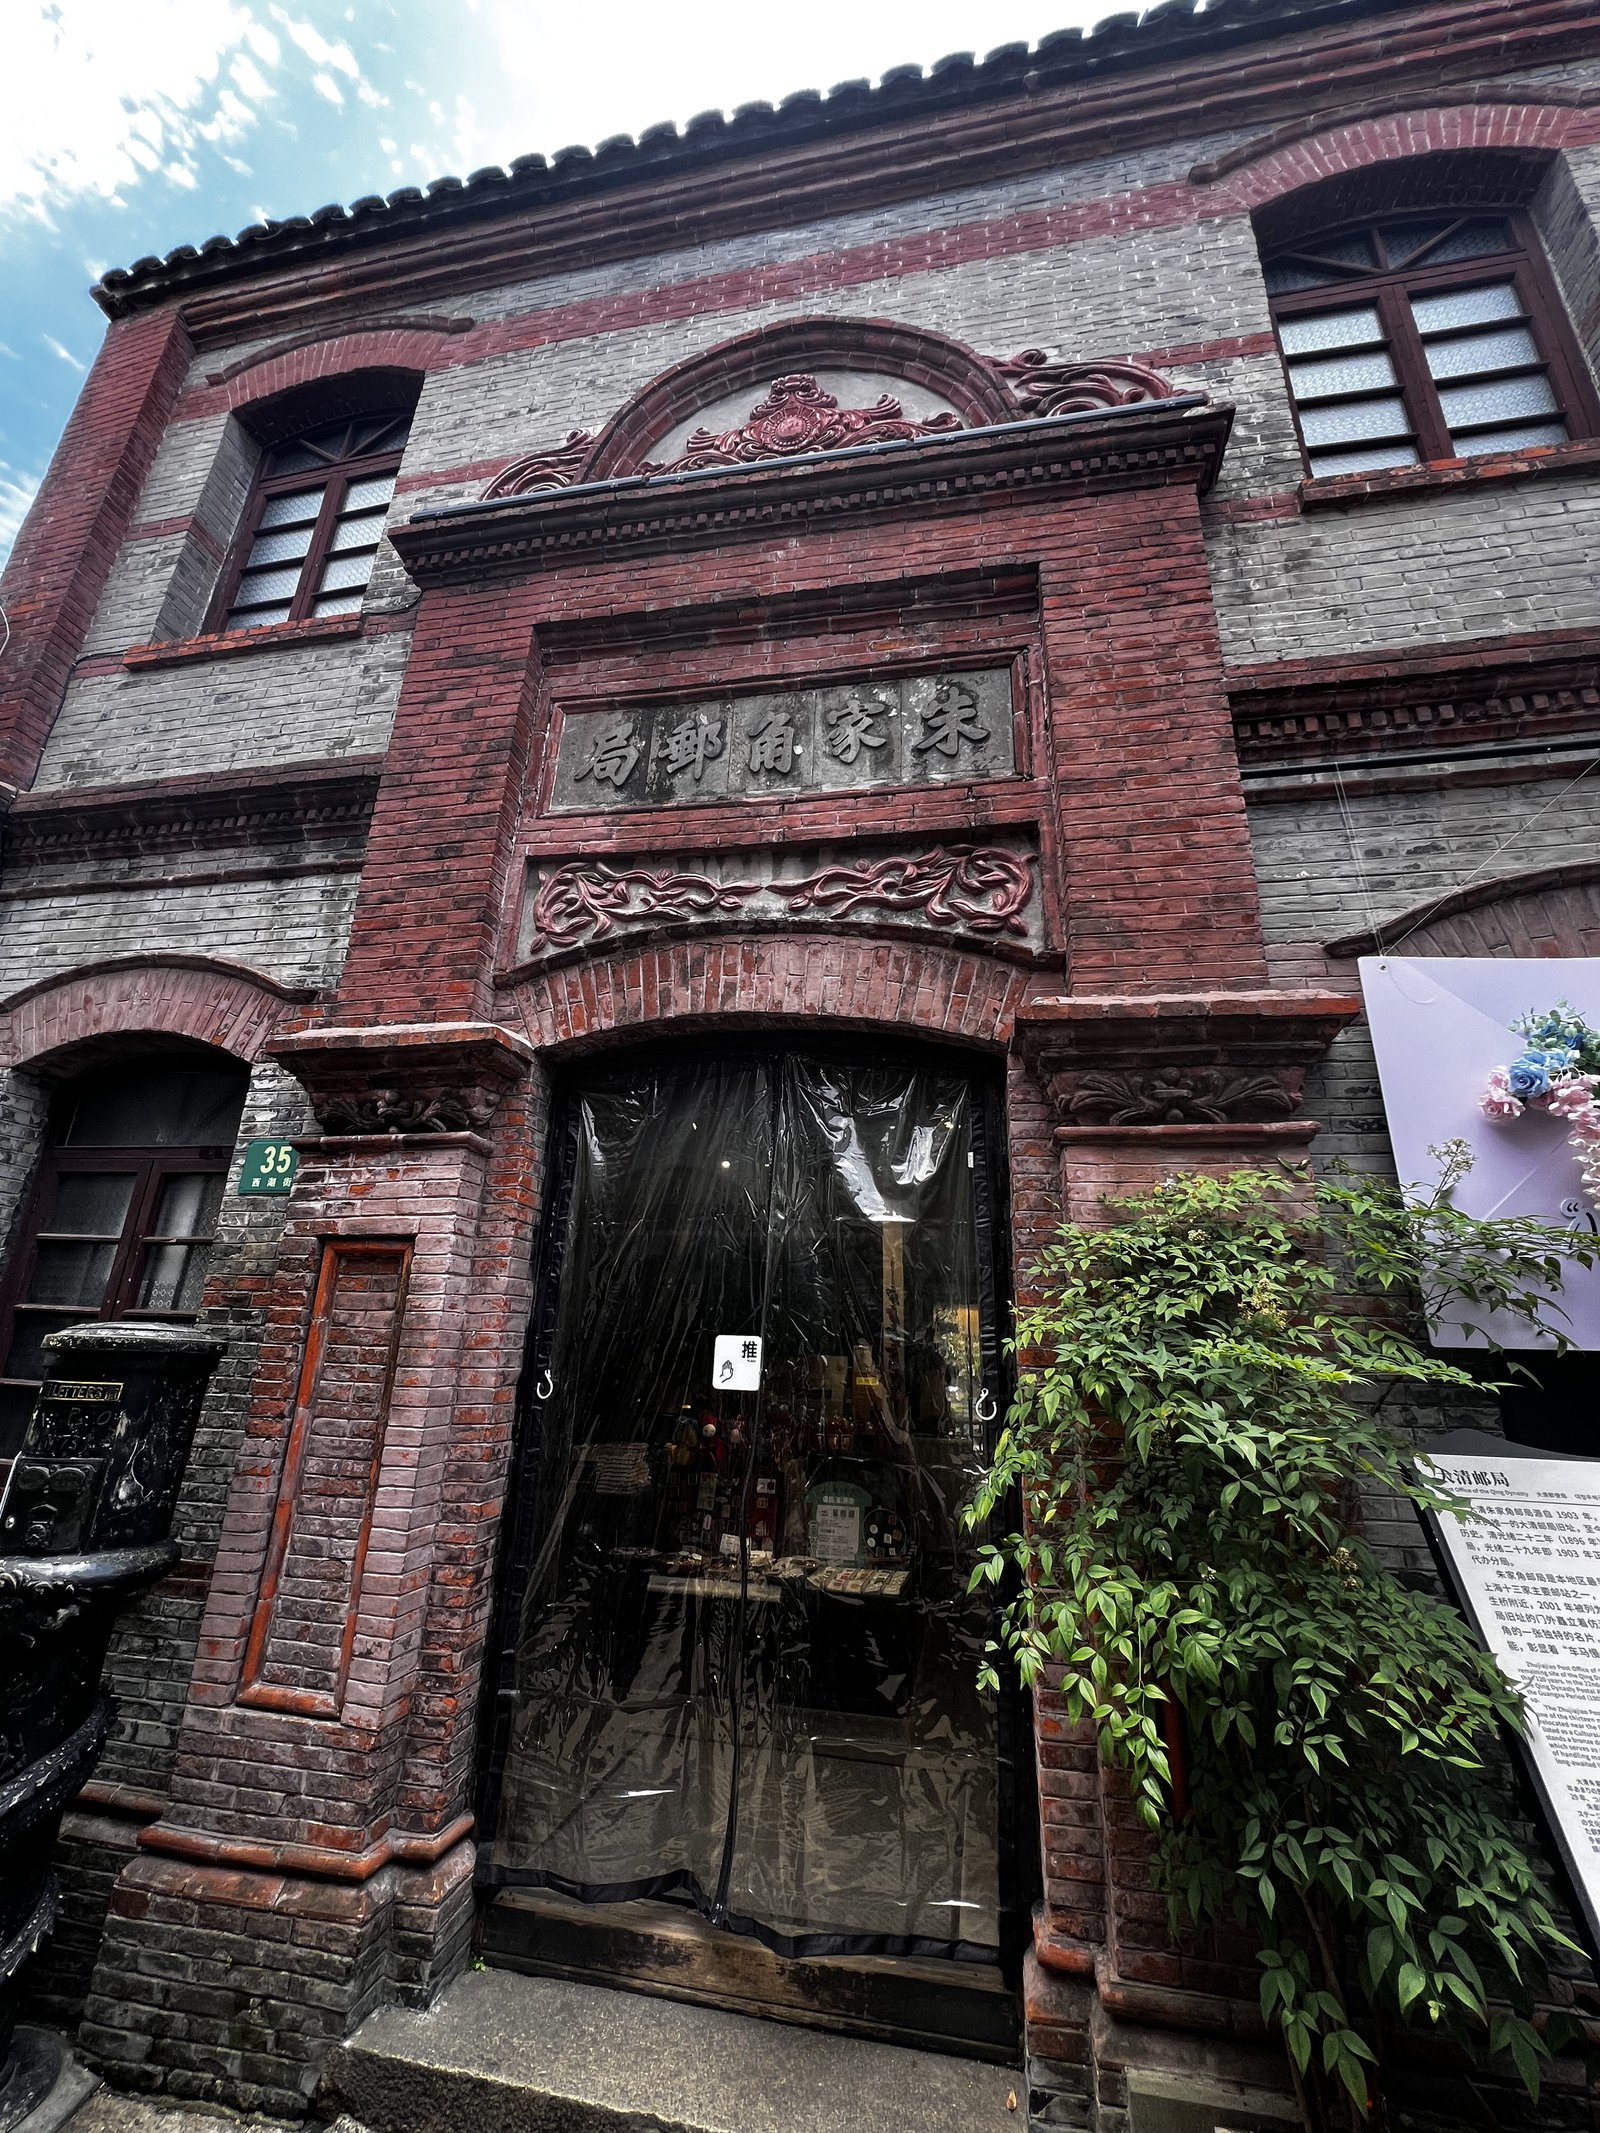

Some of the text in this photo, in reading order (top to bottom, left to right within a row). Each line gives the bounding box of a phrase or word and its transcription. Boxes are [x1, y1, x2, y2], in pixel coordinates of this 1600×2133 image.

[574, 687, 988, 786] 朱家角郵局
[260, 1145, 293, 1174] 35
[251, 1177, 293, 1188] 西湖街
[741, 1340, 758, 1359] 推
[1556, 1511, 1579, 1520] 1903
[1556, 1548, 1580, 1558] 1903
[1536, 1600, 1562, 1611] 2001
